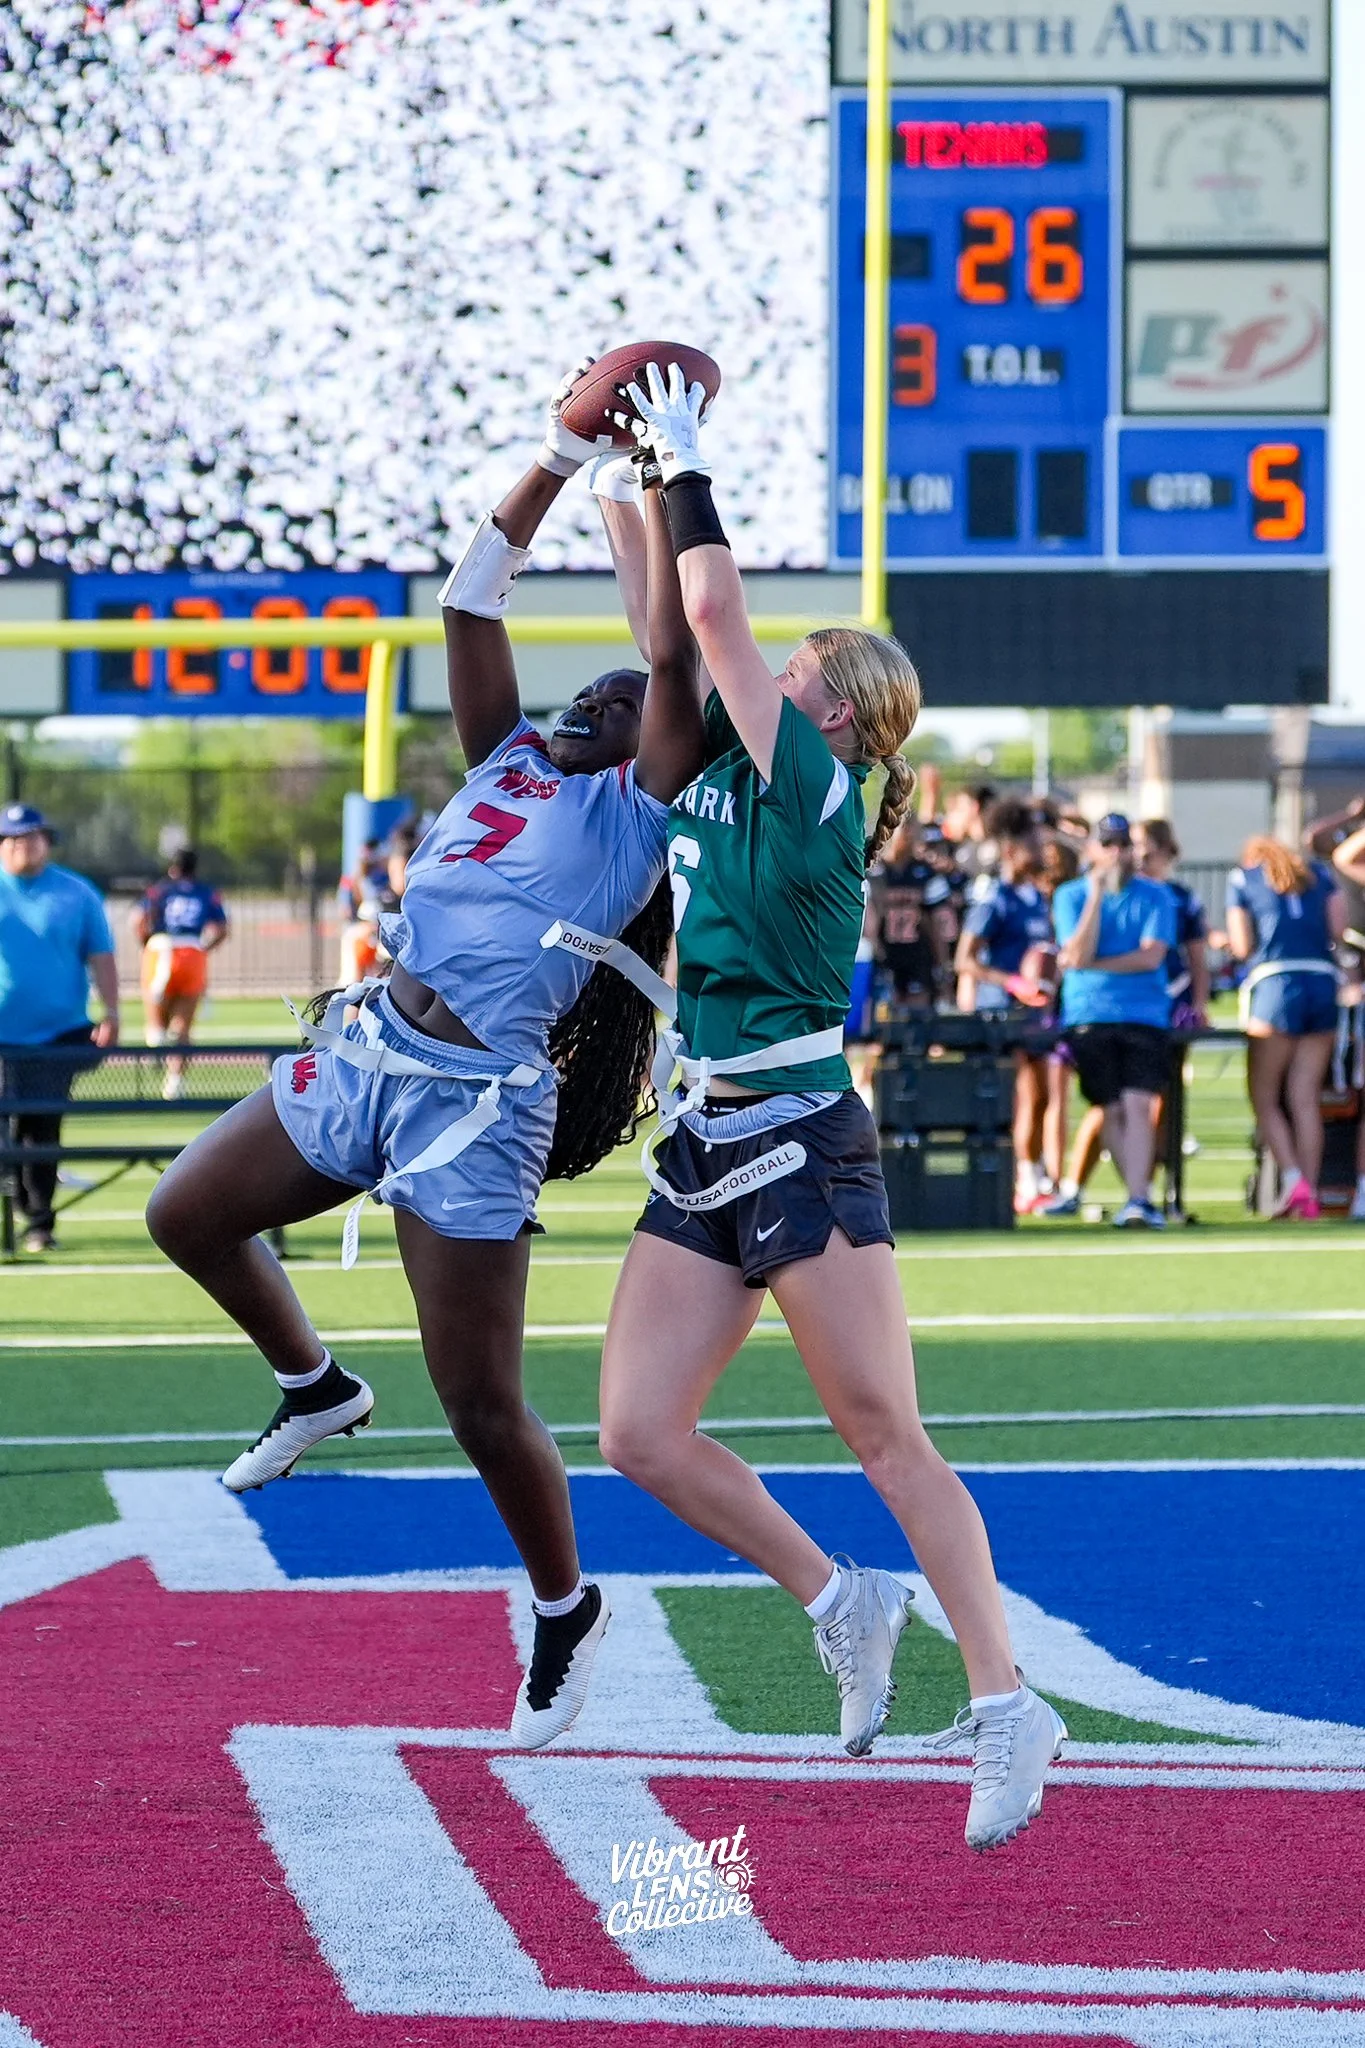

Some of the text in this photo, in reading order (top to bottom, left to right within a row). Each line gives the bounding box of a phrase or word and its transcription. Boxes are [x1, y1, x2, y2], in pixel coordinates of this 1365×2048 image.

[1094, 4, 1312, 58] AUSTIN
[957, 207, 1083, 304] 26
[893, 324, 937, 406] 3
[1249, 443, 1306, 541] 5
[439, 801, 527, 864] 7
[667, 833, 702, 933] 6
